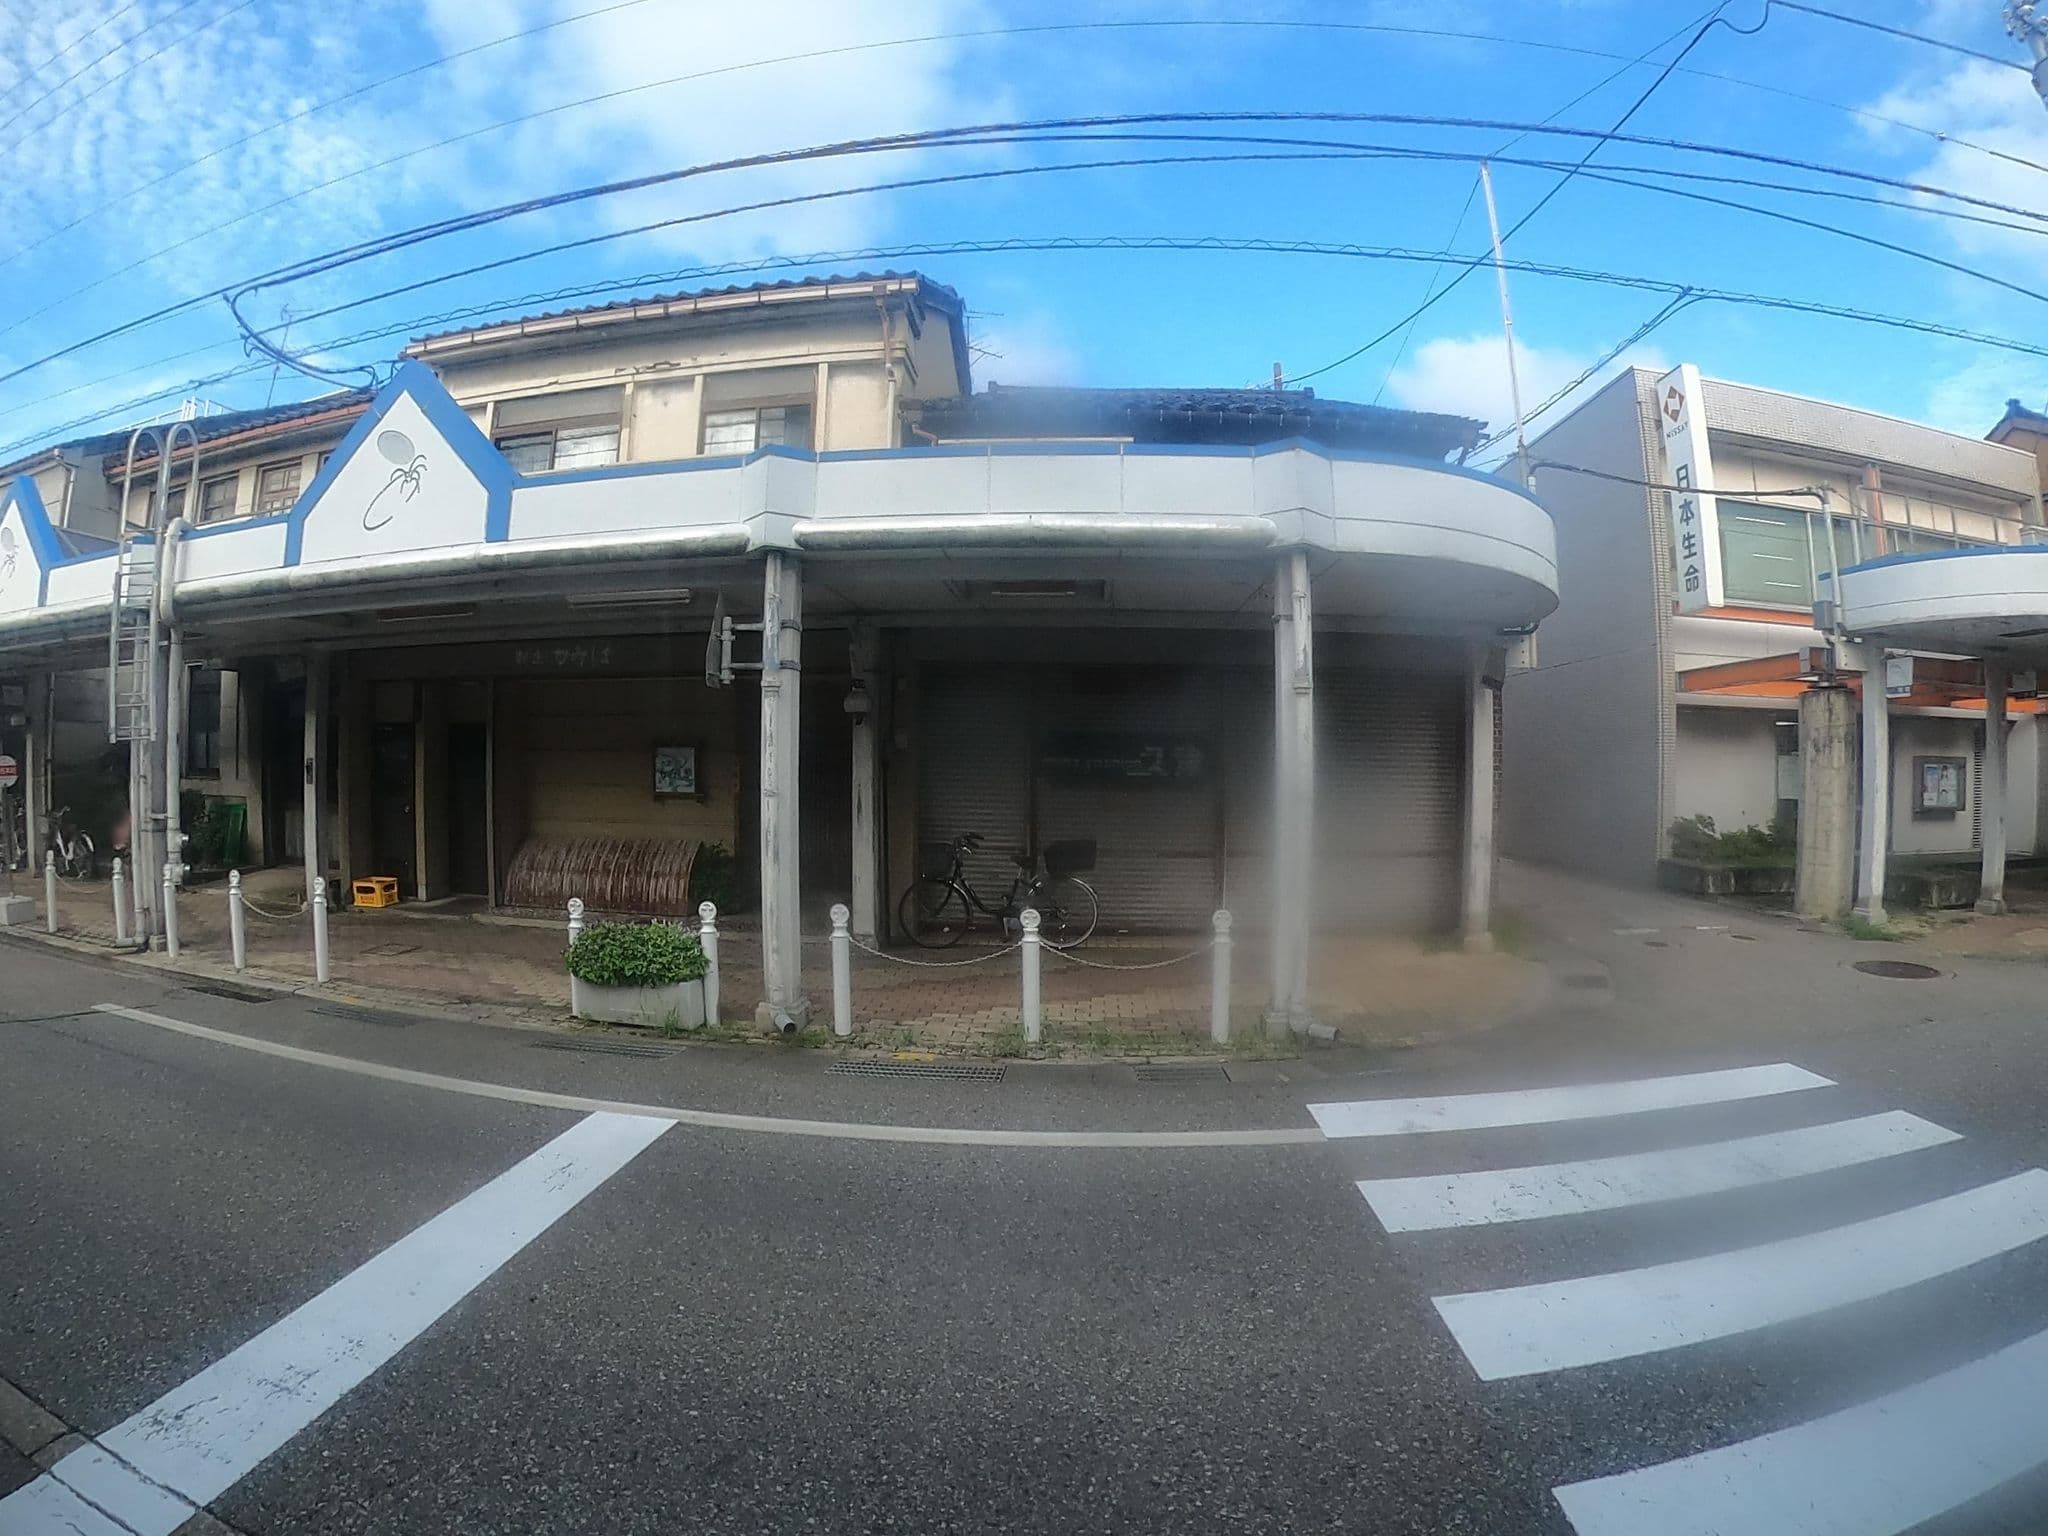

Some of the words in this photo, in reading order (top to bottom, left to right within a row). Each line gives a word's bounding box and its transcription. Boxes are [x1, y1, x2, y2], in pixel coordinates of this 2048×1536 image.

[1666, 422, 1689, 440] NISSAY
[1676, 464, 1699, 593] 日本生命
